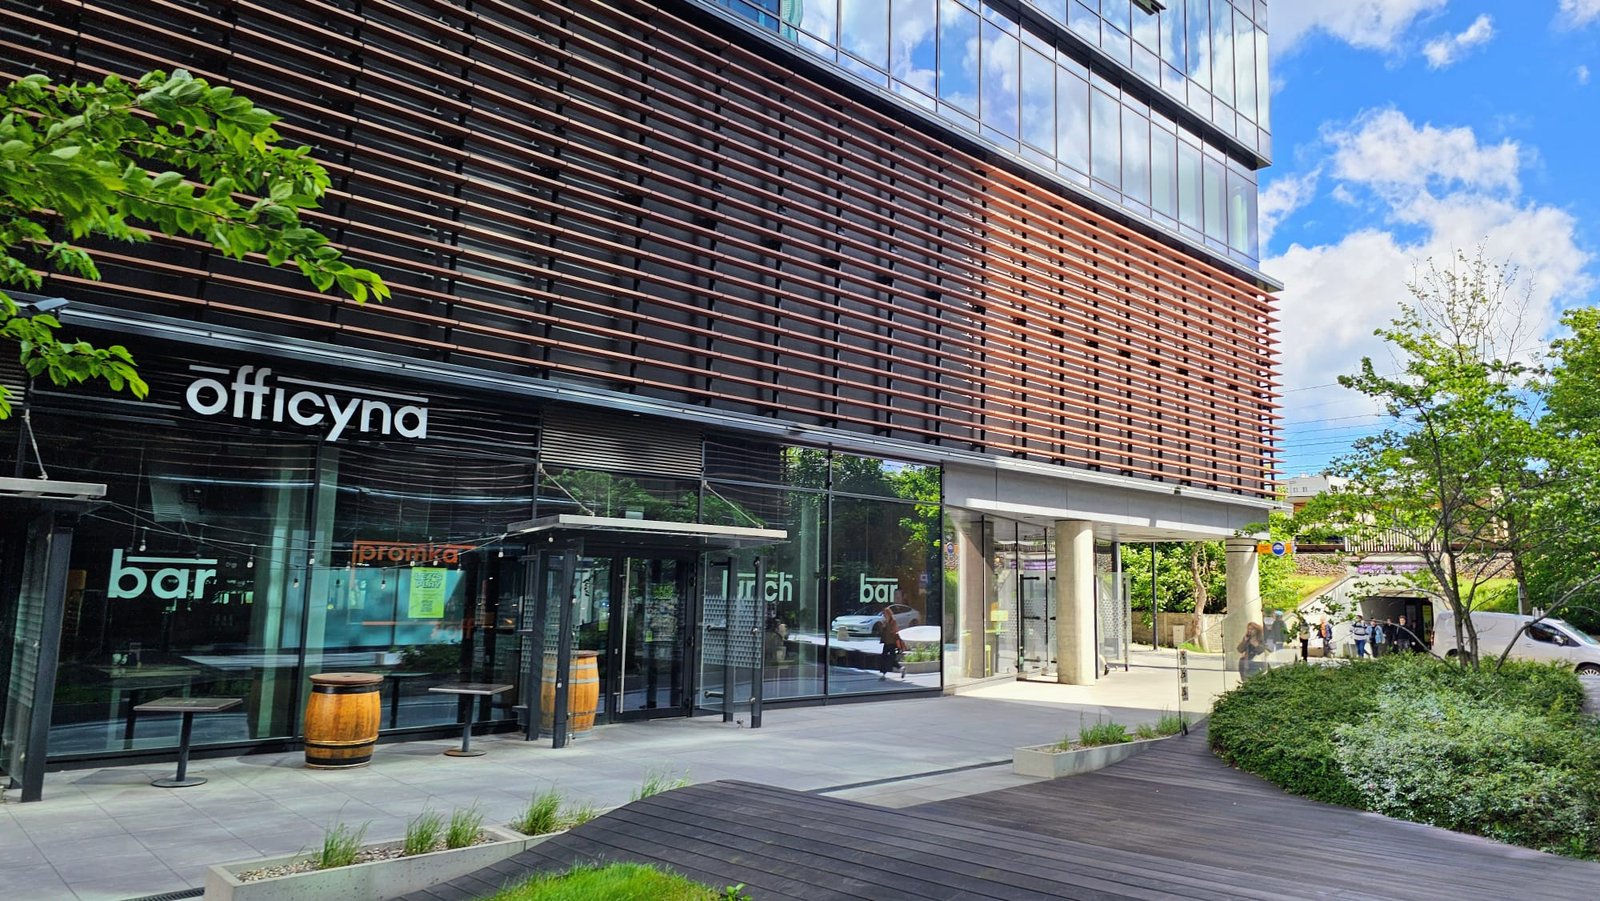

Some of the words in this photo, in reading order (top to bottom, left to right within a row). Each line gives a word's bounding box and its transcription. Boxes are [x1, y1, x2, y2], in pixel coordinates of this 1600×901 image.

[186, 365, 428, 441] officyna
[358, 543, 459, 564] promka
[108, 549, 217, 600] bar
[859, 573, 898, 603] bar
